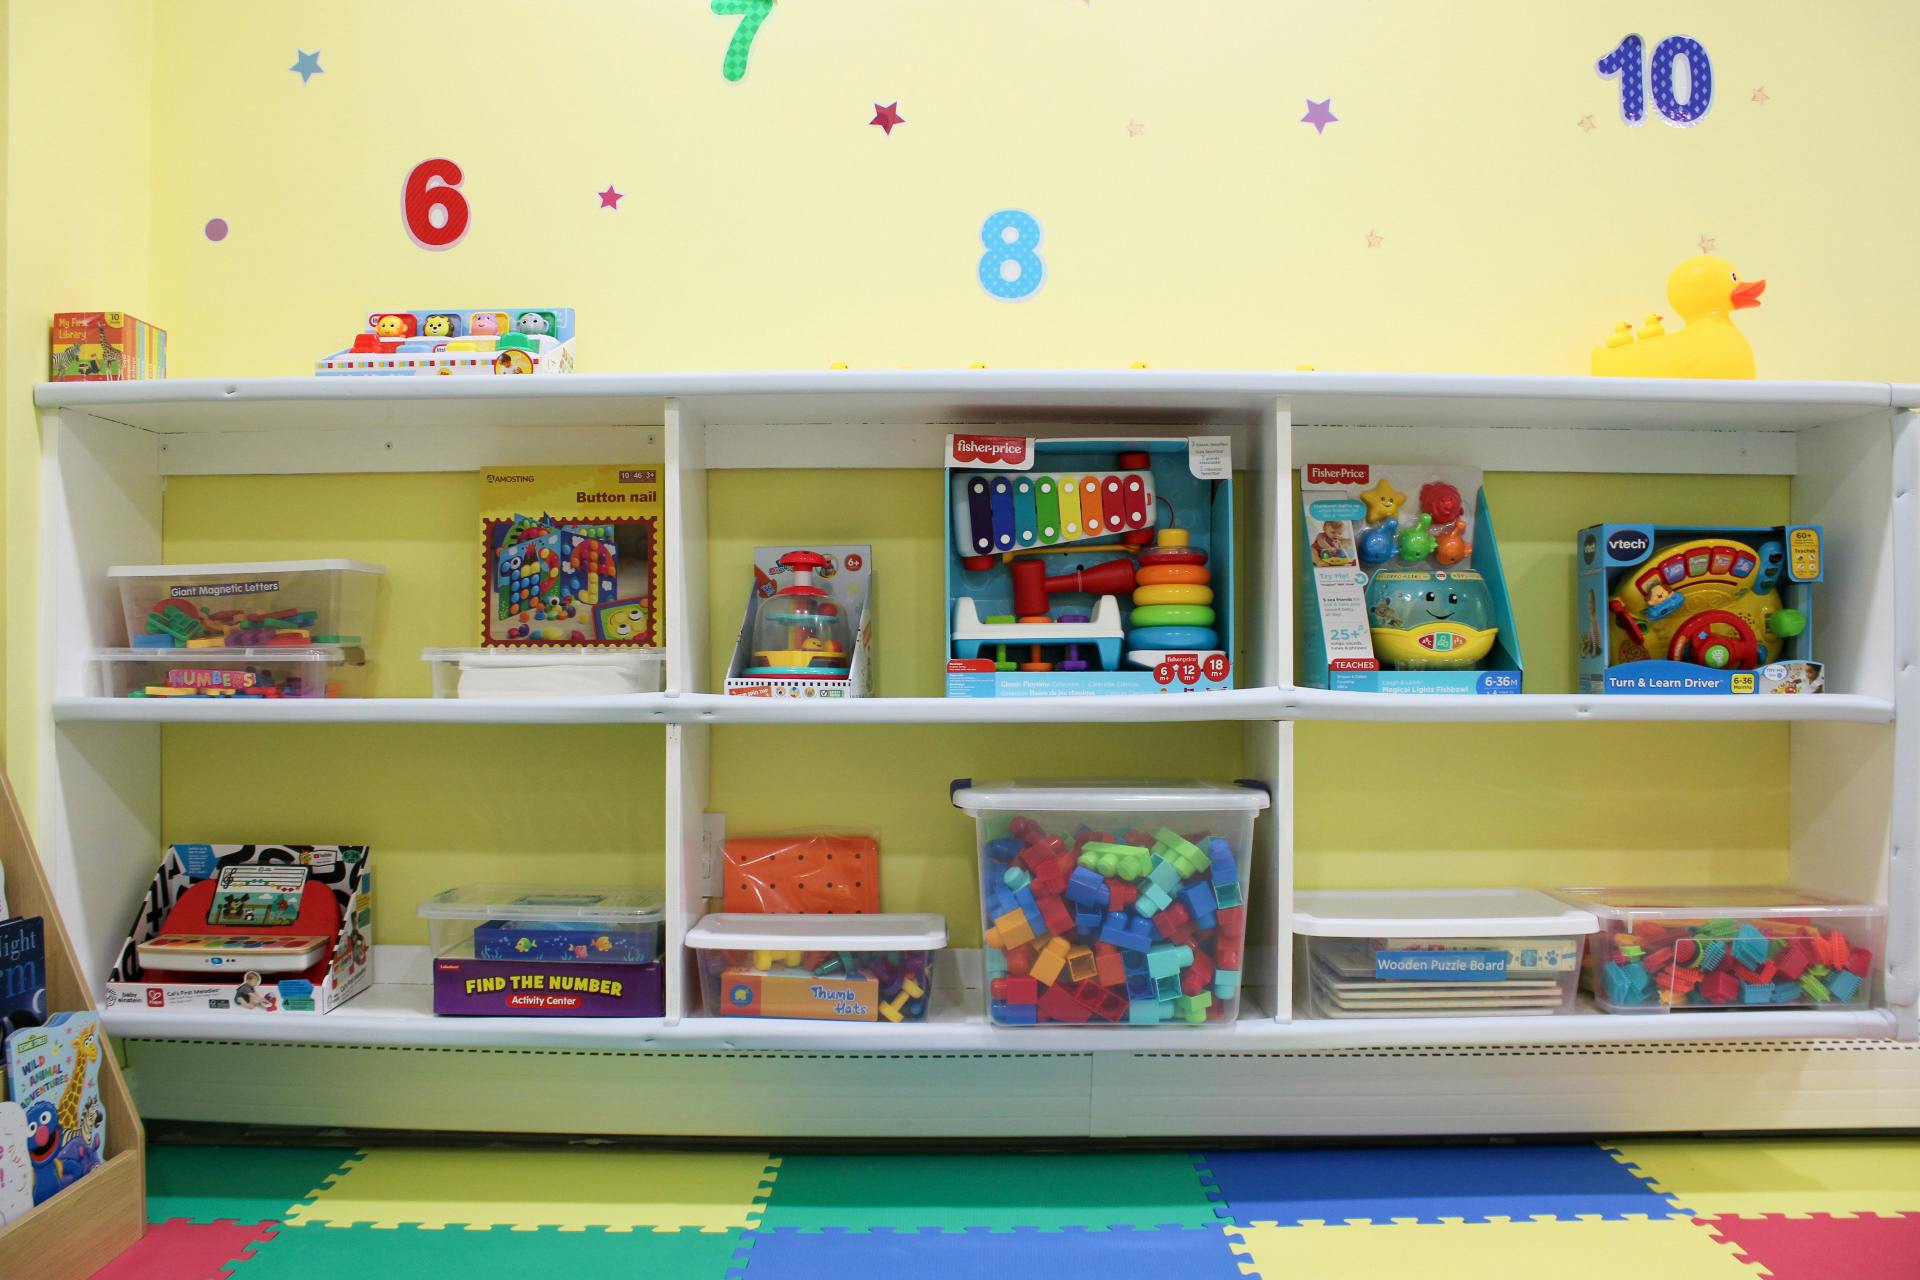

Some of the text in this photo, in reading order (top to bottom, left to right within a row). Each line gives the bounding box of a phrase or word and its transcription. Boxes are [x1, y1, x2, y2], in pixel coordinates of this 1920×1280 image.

[711, 0, 775, 81] 7
[1595, 34, 1714, 125] 10
[404, 158, 470, 248] 6
[978, 208, 1045, 301] 8
[957, 440, 1022, 455] fisher-price
[494, 475, 535, 483] AMOSTING
[1312, 467, 1366, 479] Fisher-Price
[576, 491, 657, 504] Button nail
[1608, 538, 1647, 550] vtech
[847, 558, 860, 567] 6+
[171, 582, 279, 597] Giant Magnetic Letters
[1330, 628, 1360, 641] 25+
[1160, 667, 1168, 675] 6
[1183, 665, 1195, 675] 12
[1210, 659, 1223, 670] 18
[1335, 661, 1375, 669] TEACHES
[170, 671, 253, 687] NUMBERS
[1609, 677, 1720, 688] Turn & Learn Driver
[0, 928, 36, 960] ight
[1377, 959, 1504, 971] Wooden Puzzle Board
[466, 975, 623, 997] FIND THE NUMBER
[810, 986, 856, 1001] Thumb
[512, 996, 577, 1007] Activity Center
[834, 1002, 868, 1015] Hats
[22, 1055, 46, 1076] WILD
[30, 1063, 63, 1087] ANIMAL
